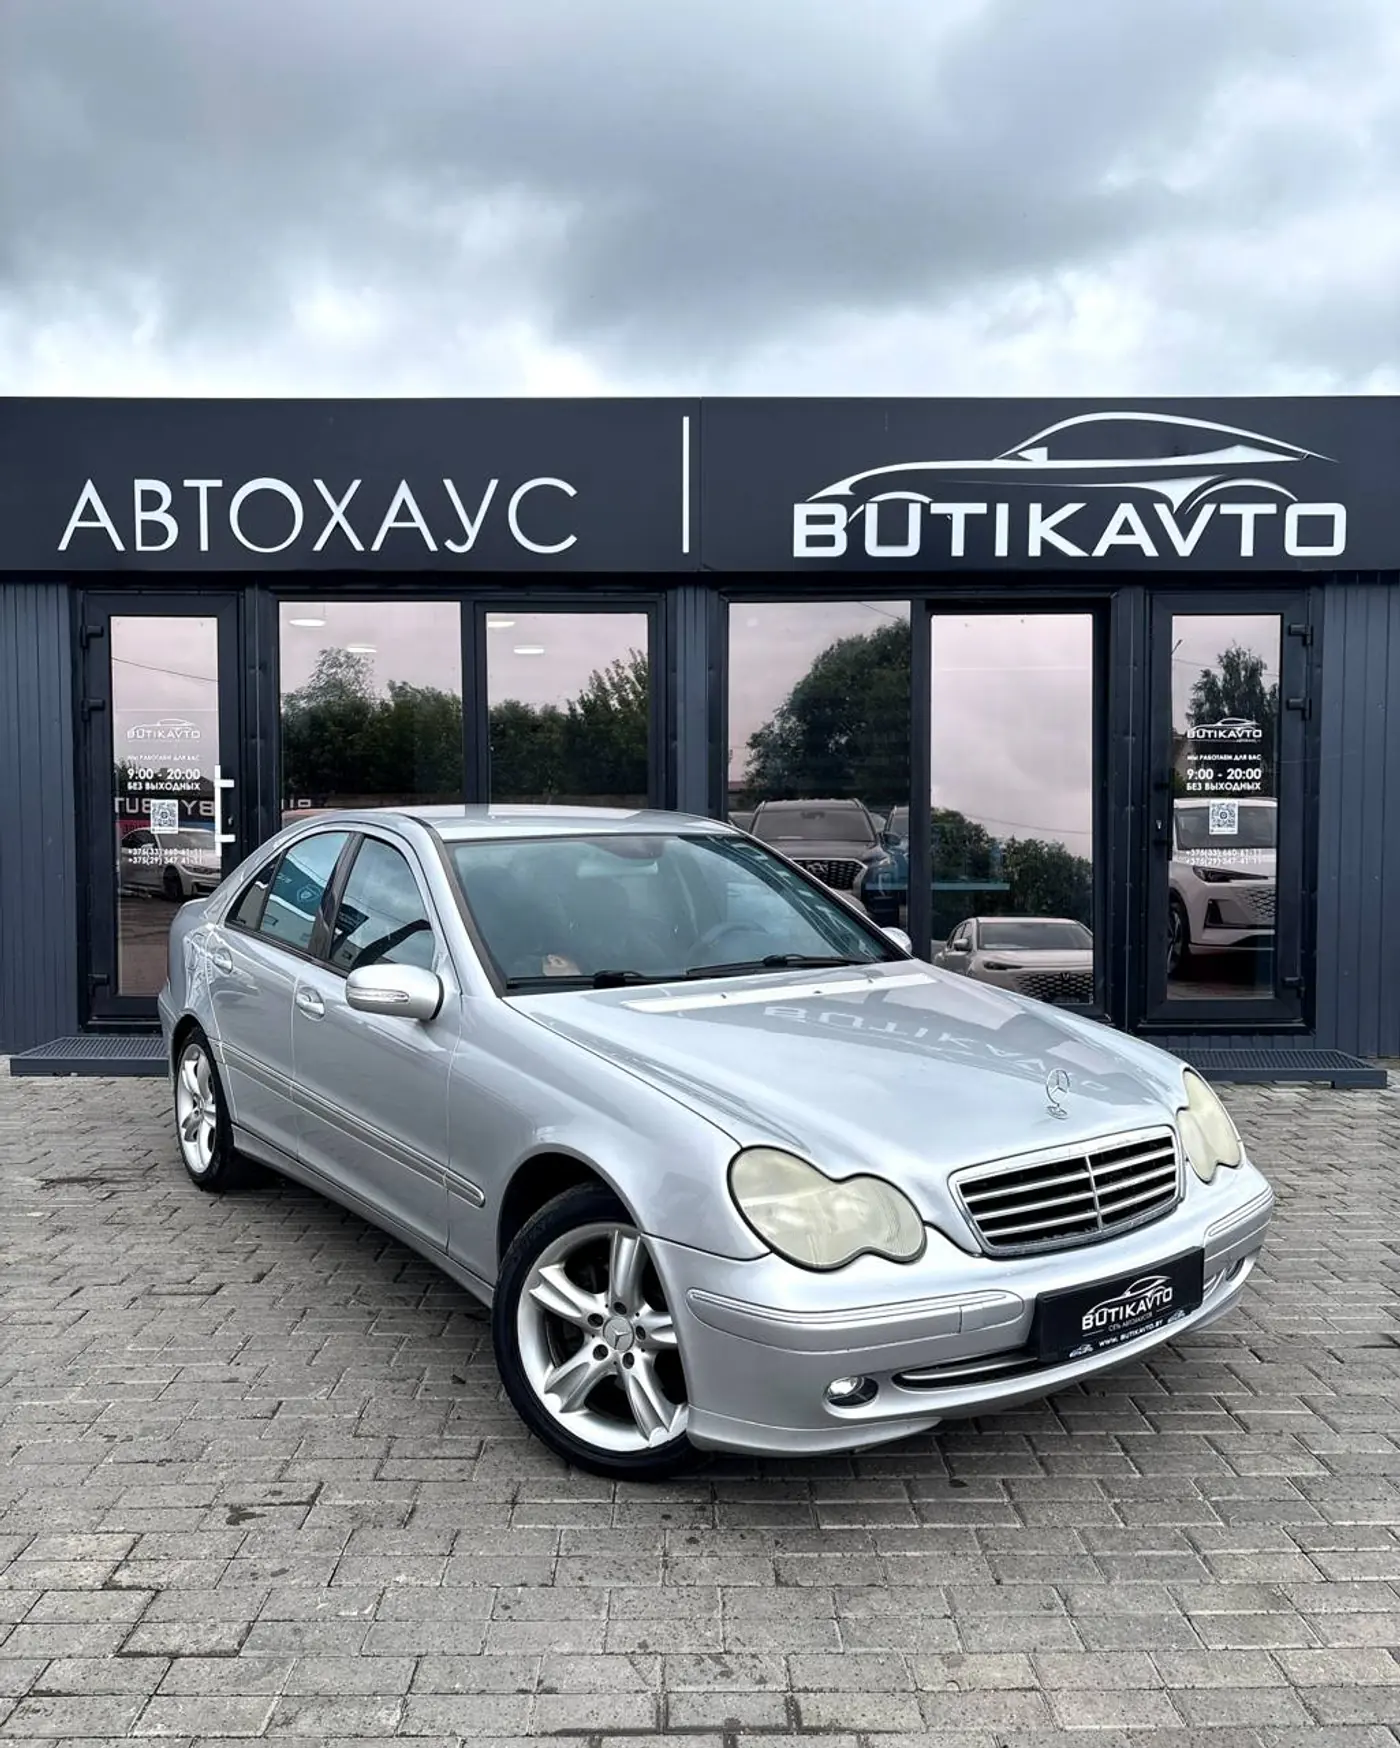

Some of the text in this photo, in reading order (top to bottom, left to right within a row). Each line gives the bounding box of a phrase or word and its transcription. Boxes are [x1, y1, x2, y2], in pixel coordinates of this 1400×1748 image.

[58, 477, 579, 554] АВТОХАУС
[792, 502, 1347, 558] BUTIKAVTO
[1187, 729, 1262, 739] BUTIKAVTO
[127, 768, 154, 780] 9:00
[166, 768, 201, 780] 20:00
[1186, 768, 1214, 780] 9:00
[1226, 768, 1262, 780] 20:00
[127, 782, 201, 792] БЕЗ ВЫХОДНЫХ
[1186, 782, 1261, 792] БЕЗ ВЫХОДНЫХ
[1082, 1286, 1173, 1331] BUTIKAVTO
